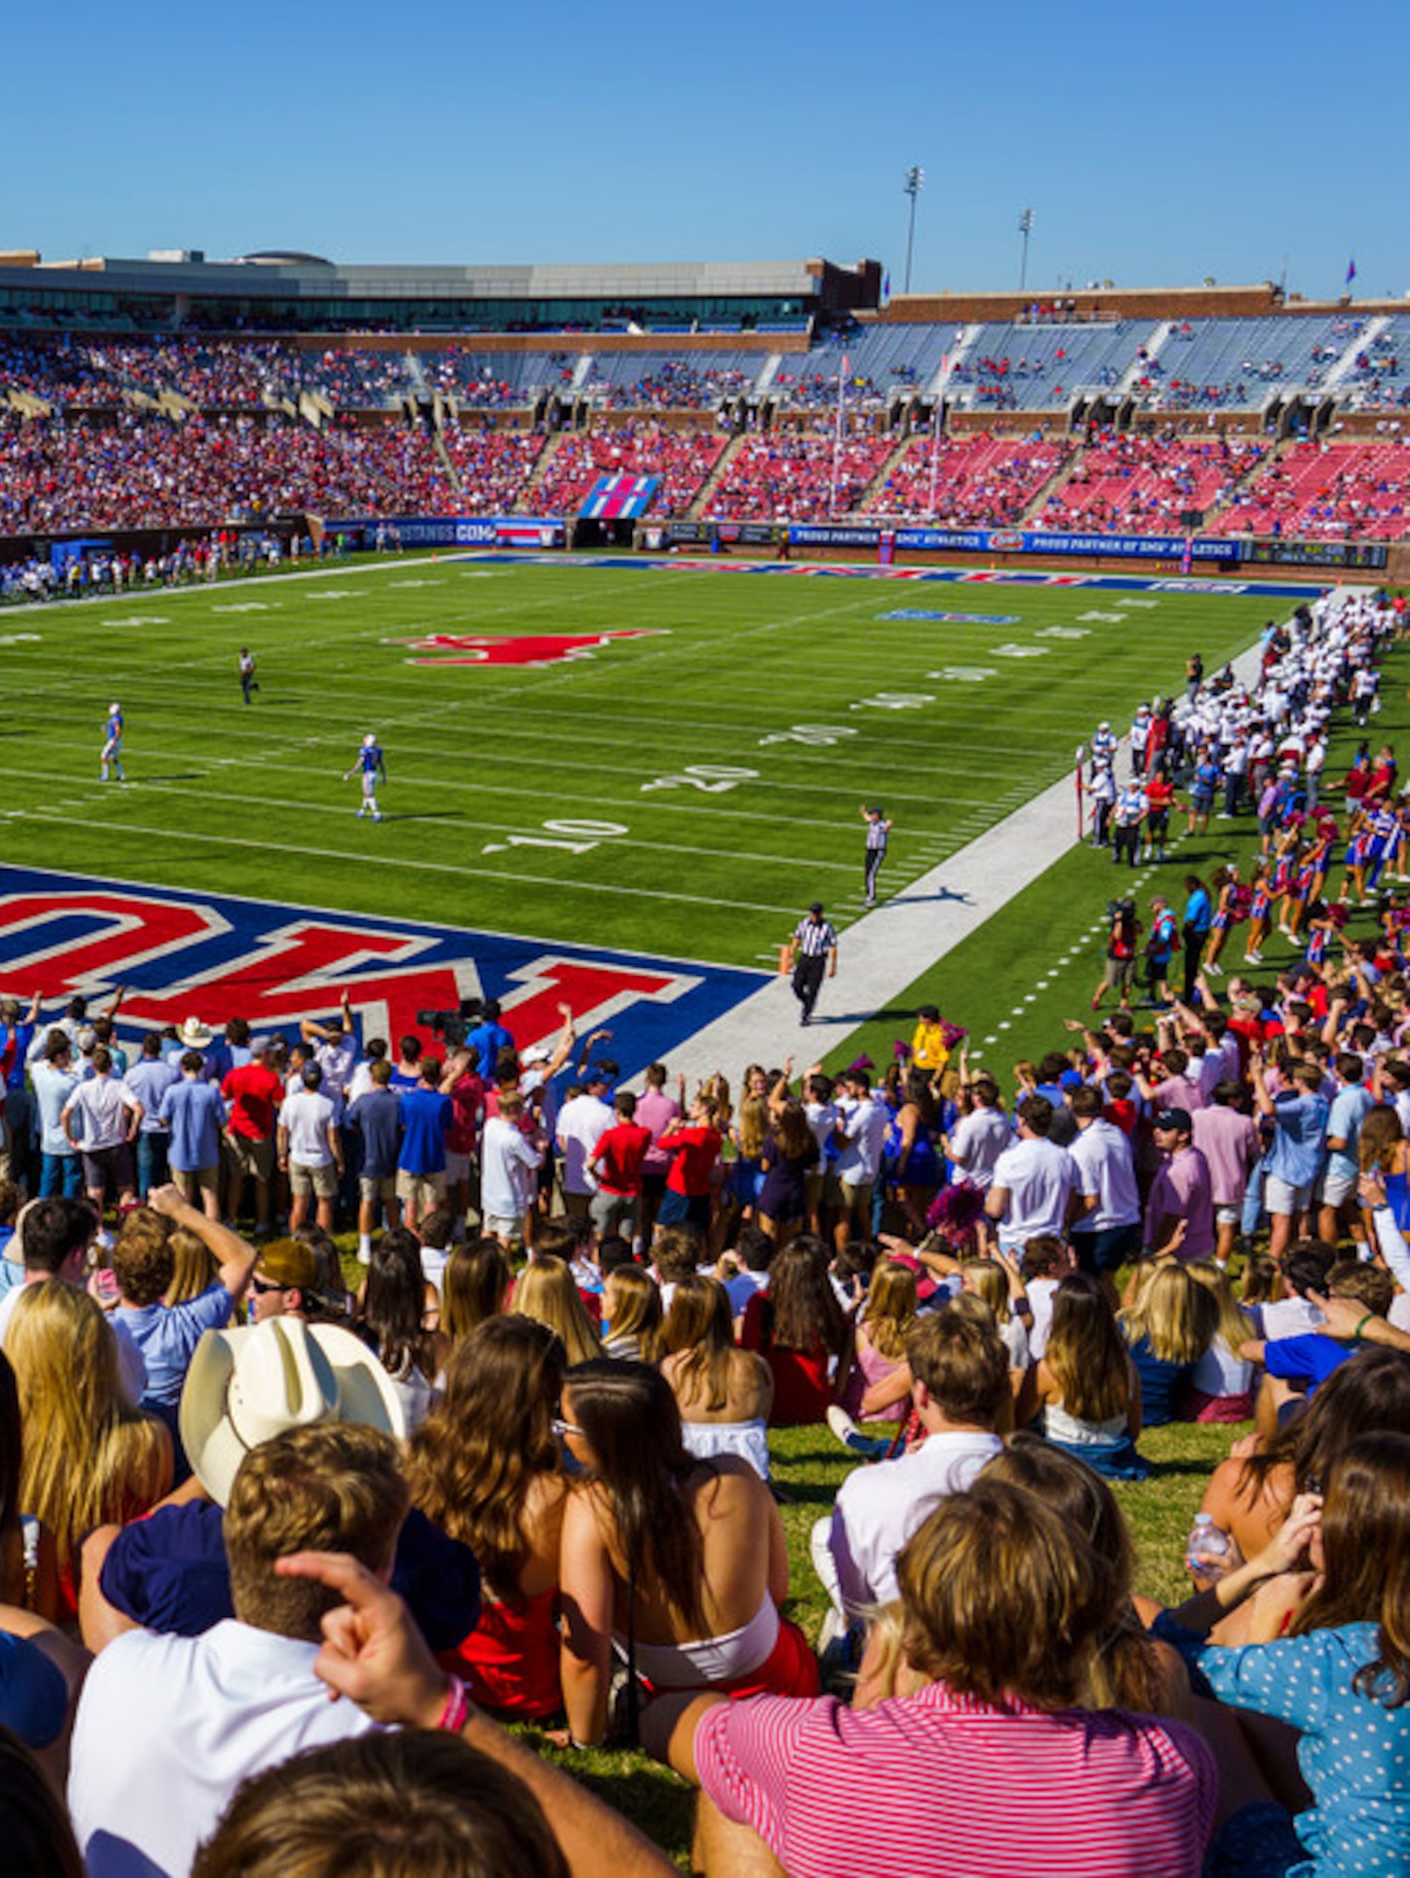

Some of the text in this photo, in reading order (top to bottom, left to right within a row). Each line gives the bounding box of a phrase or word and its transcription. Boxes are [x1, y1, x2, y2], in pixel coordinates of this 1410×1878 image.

[796, 530, 829, 542] PROUD
[1032, 537, 1069, 549] PROUD
[1071, 539, 1121, 551] PARTNER
[1123, 541, 1139, 552] OF
[1169, 543, 1232, 556] ATLETICS
[505, 818, 630, 855] 10
